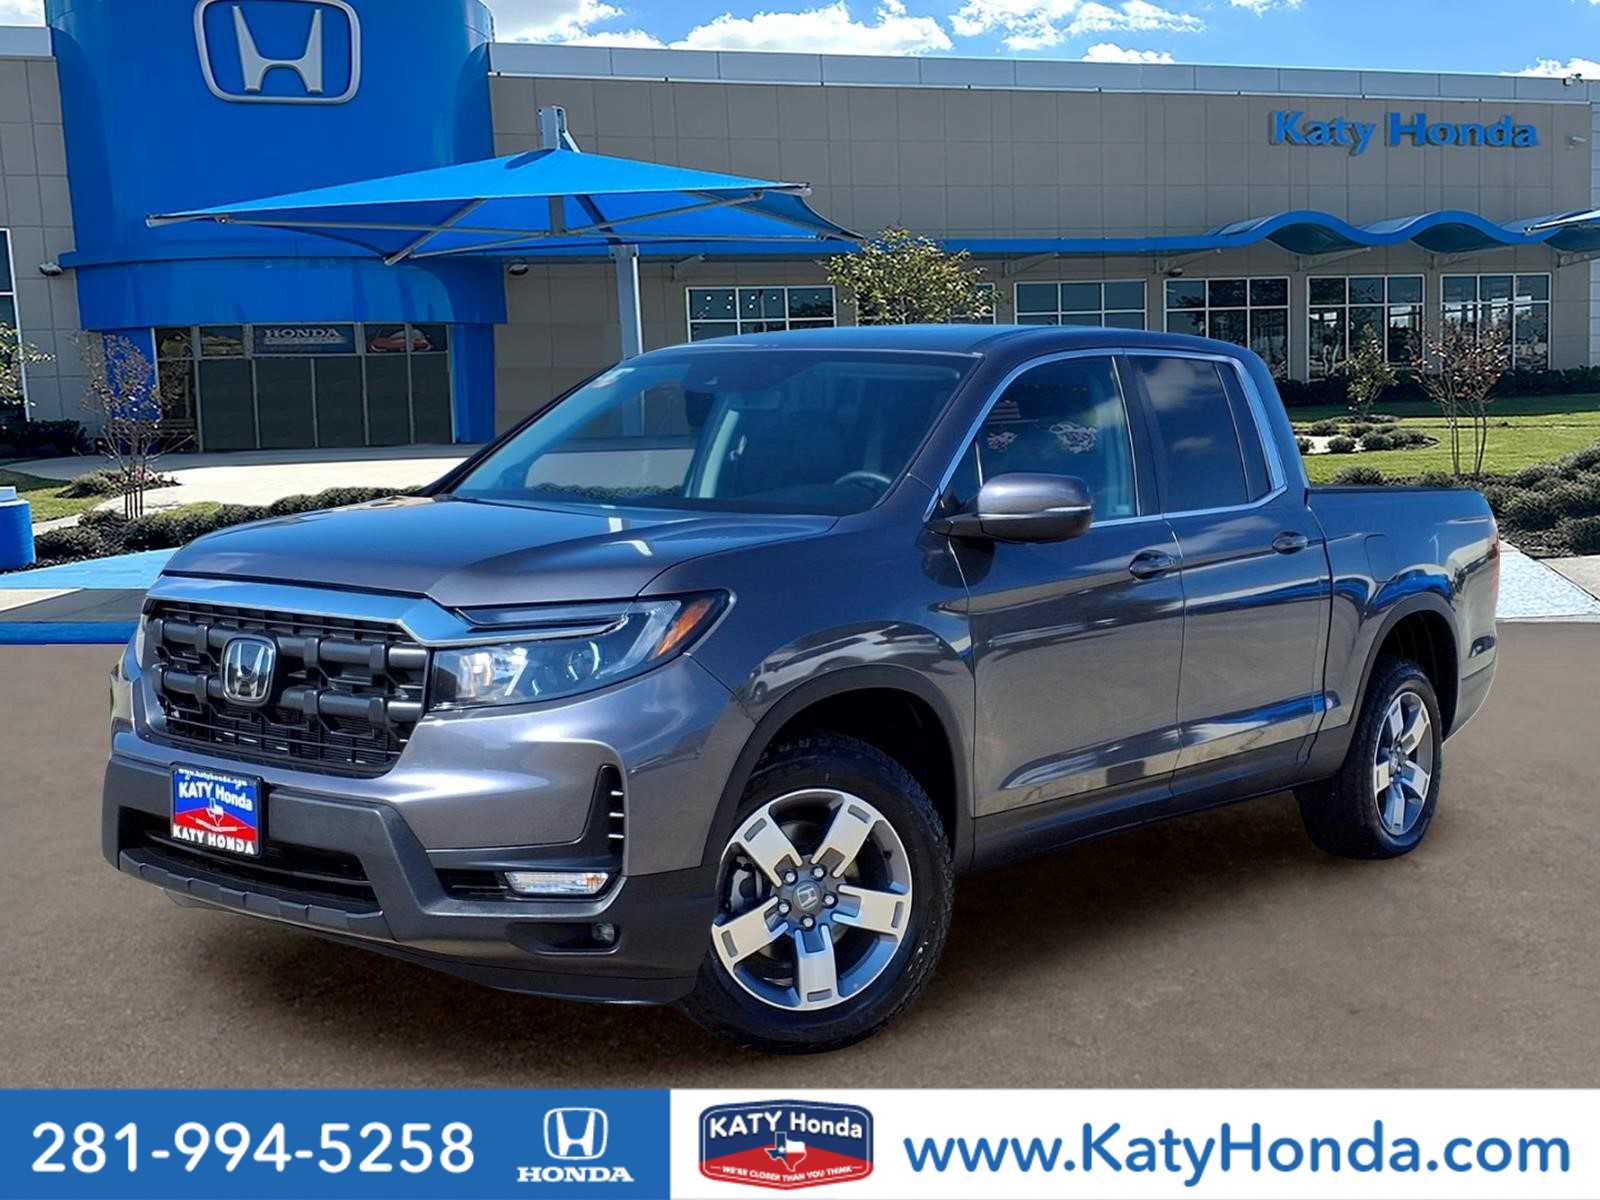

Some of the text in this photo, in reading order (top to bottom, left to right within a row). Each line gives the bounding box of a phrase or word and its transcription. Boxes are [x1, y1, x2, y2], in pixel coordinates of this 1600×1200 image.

[1270, 110, 1538, 156] Katy Honda
[264, 328, 341, 338] HONDA
[178, 781, 254, 811] KATY Honda
[173, 824, 255, 855] KATY HONDA
